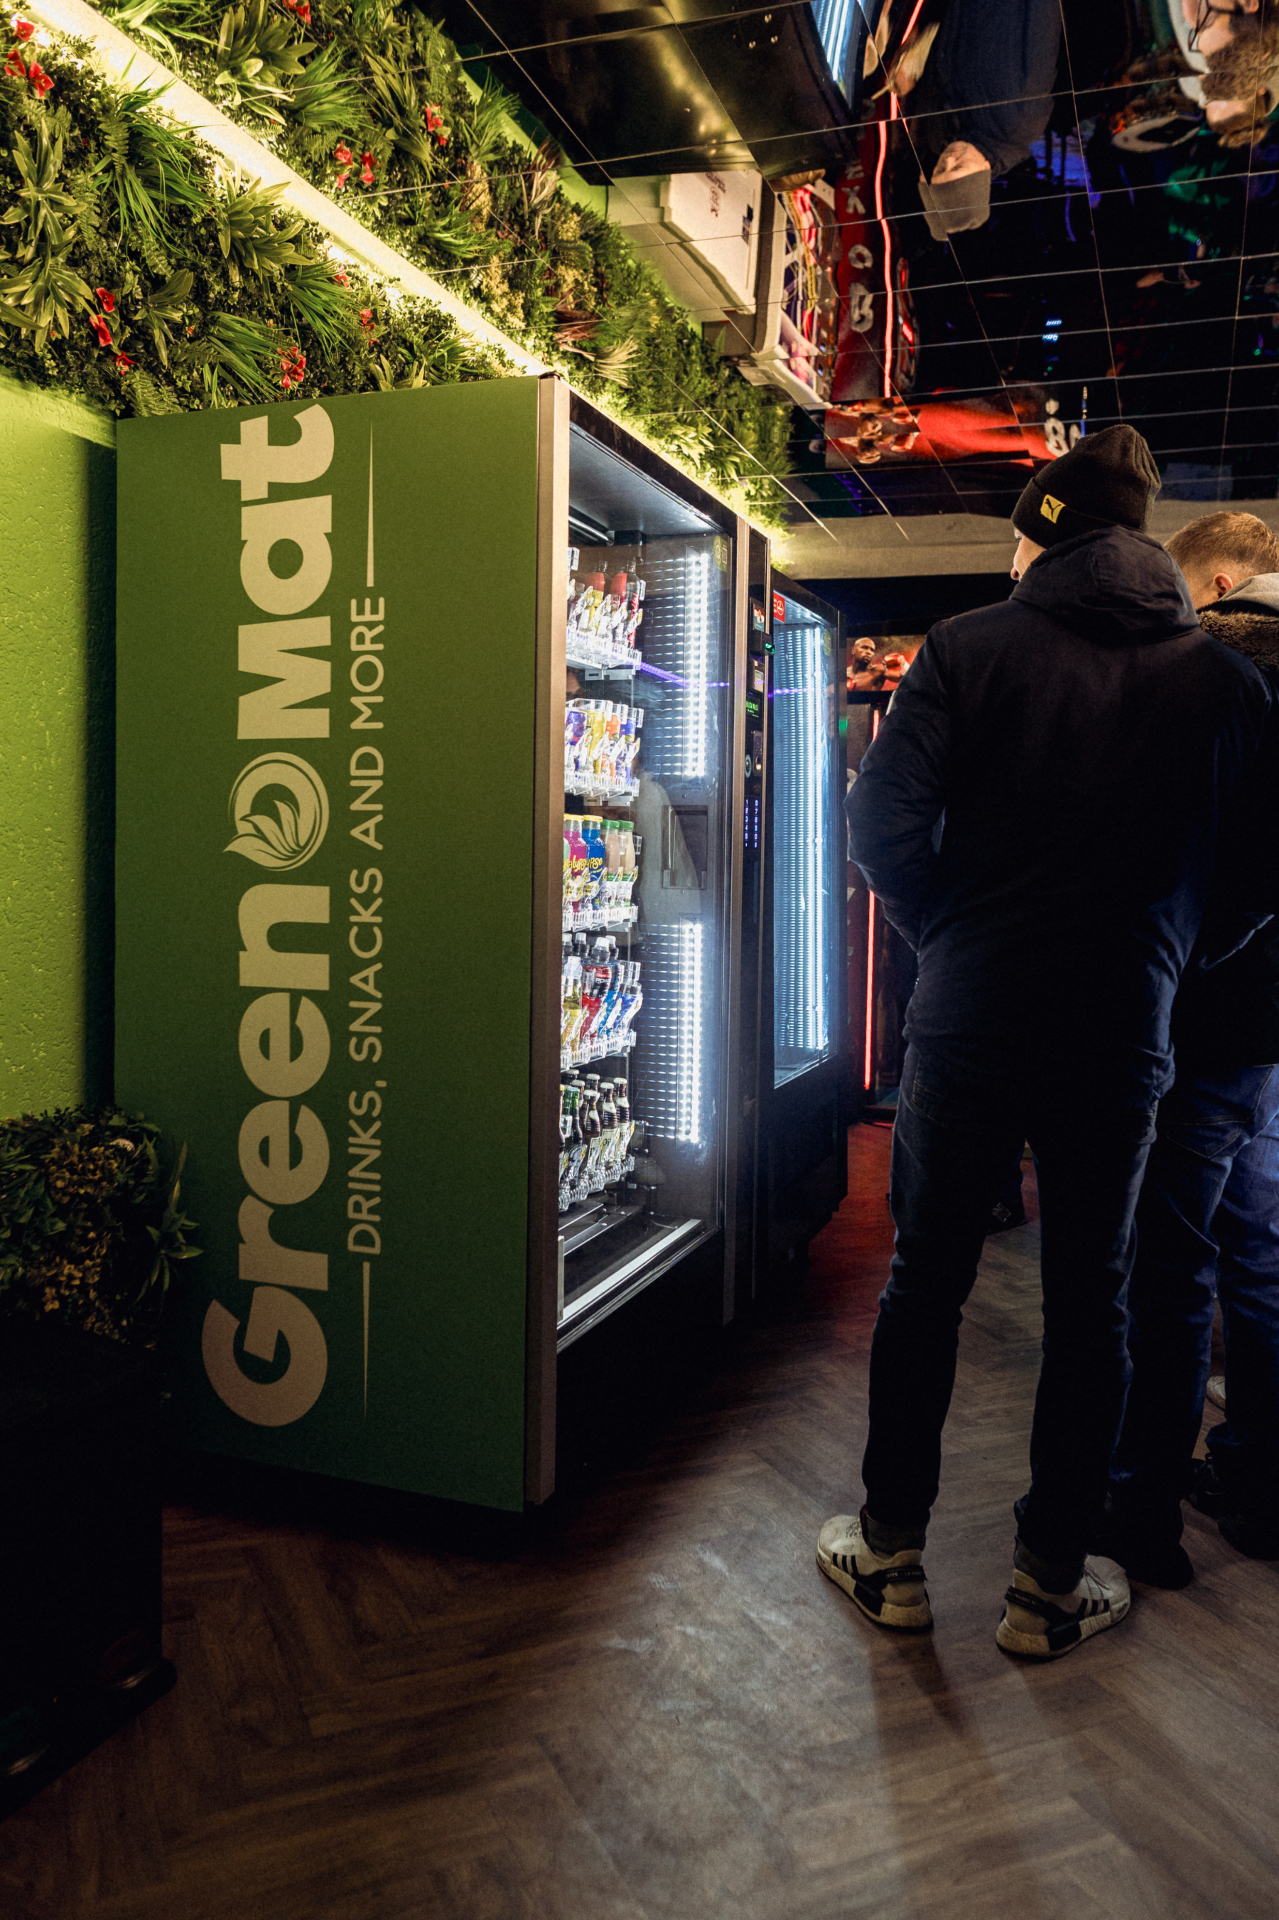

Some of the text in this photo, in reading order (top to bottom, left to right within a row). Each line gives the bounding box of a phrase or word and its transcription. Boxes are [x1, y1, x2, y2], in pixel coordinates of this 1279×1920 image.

[347, 597, 388, 1255] DRINKS, SNACKS AND MORE
